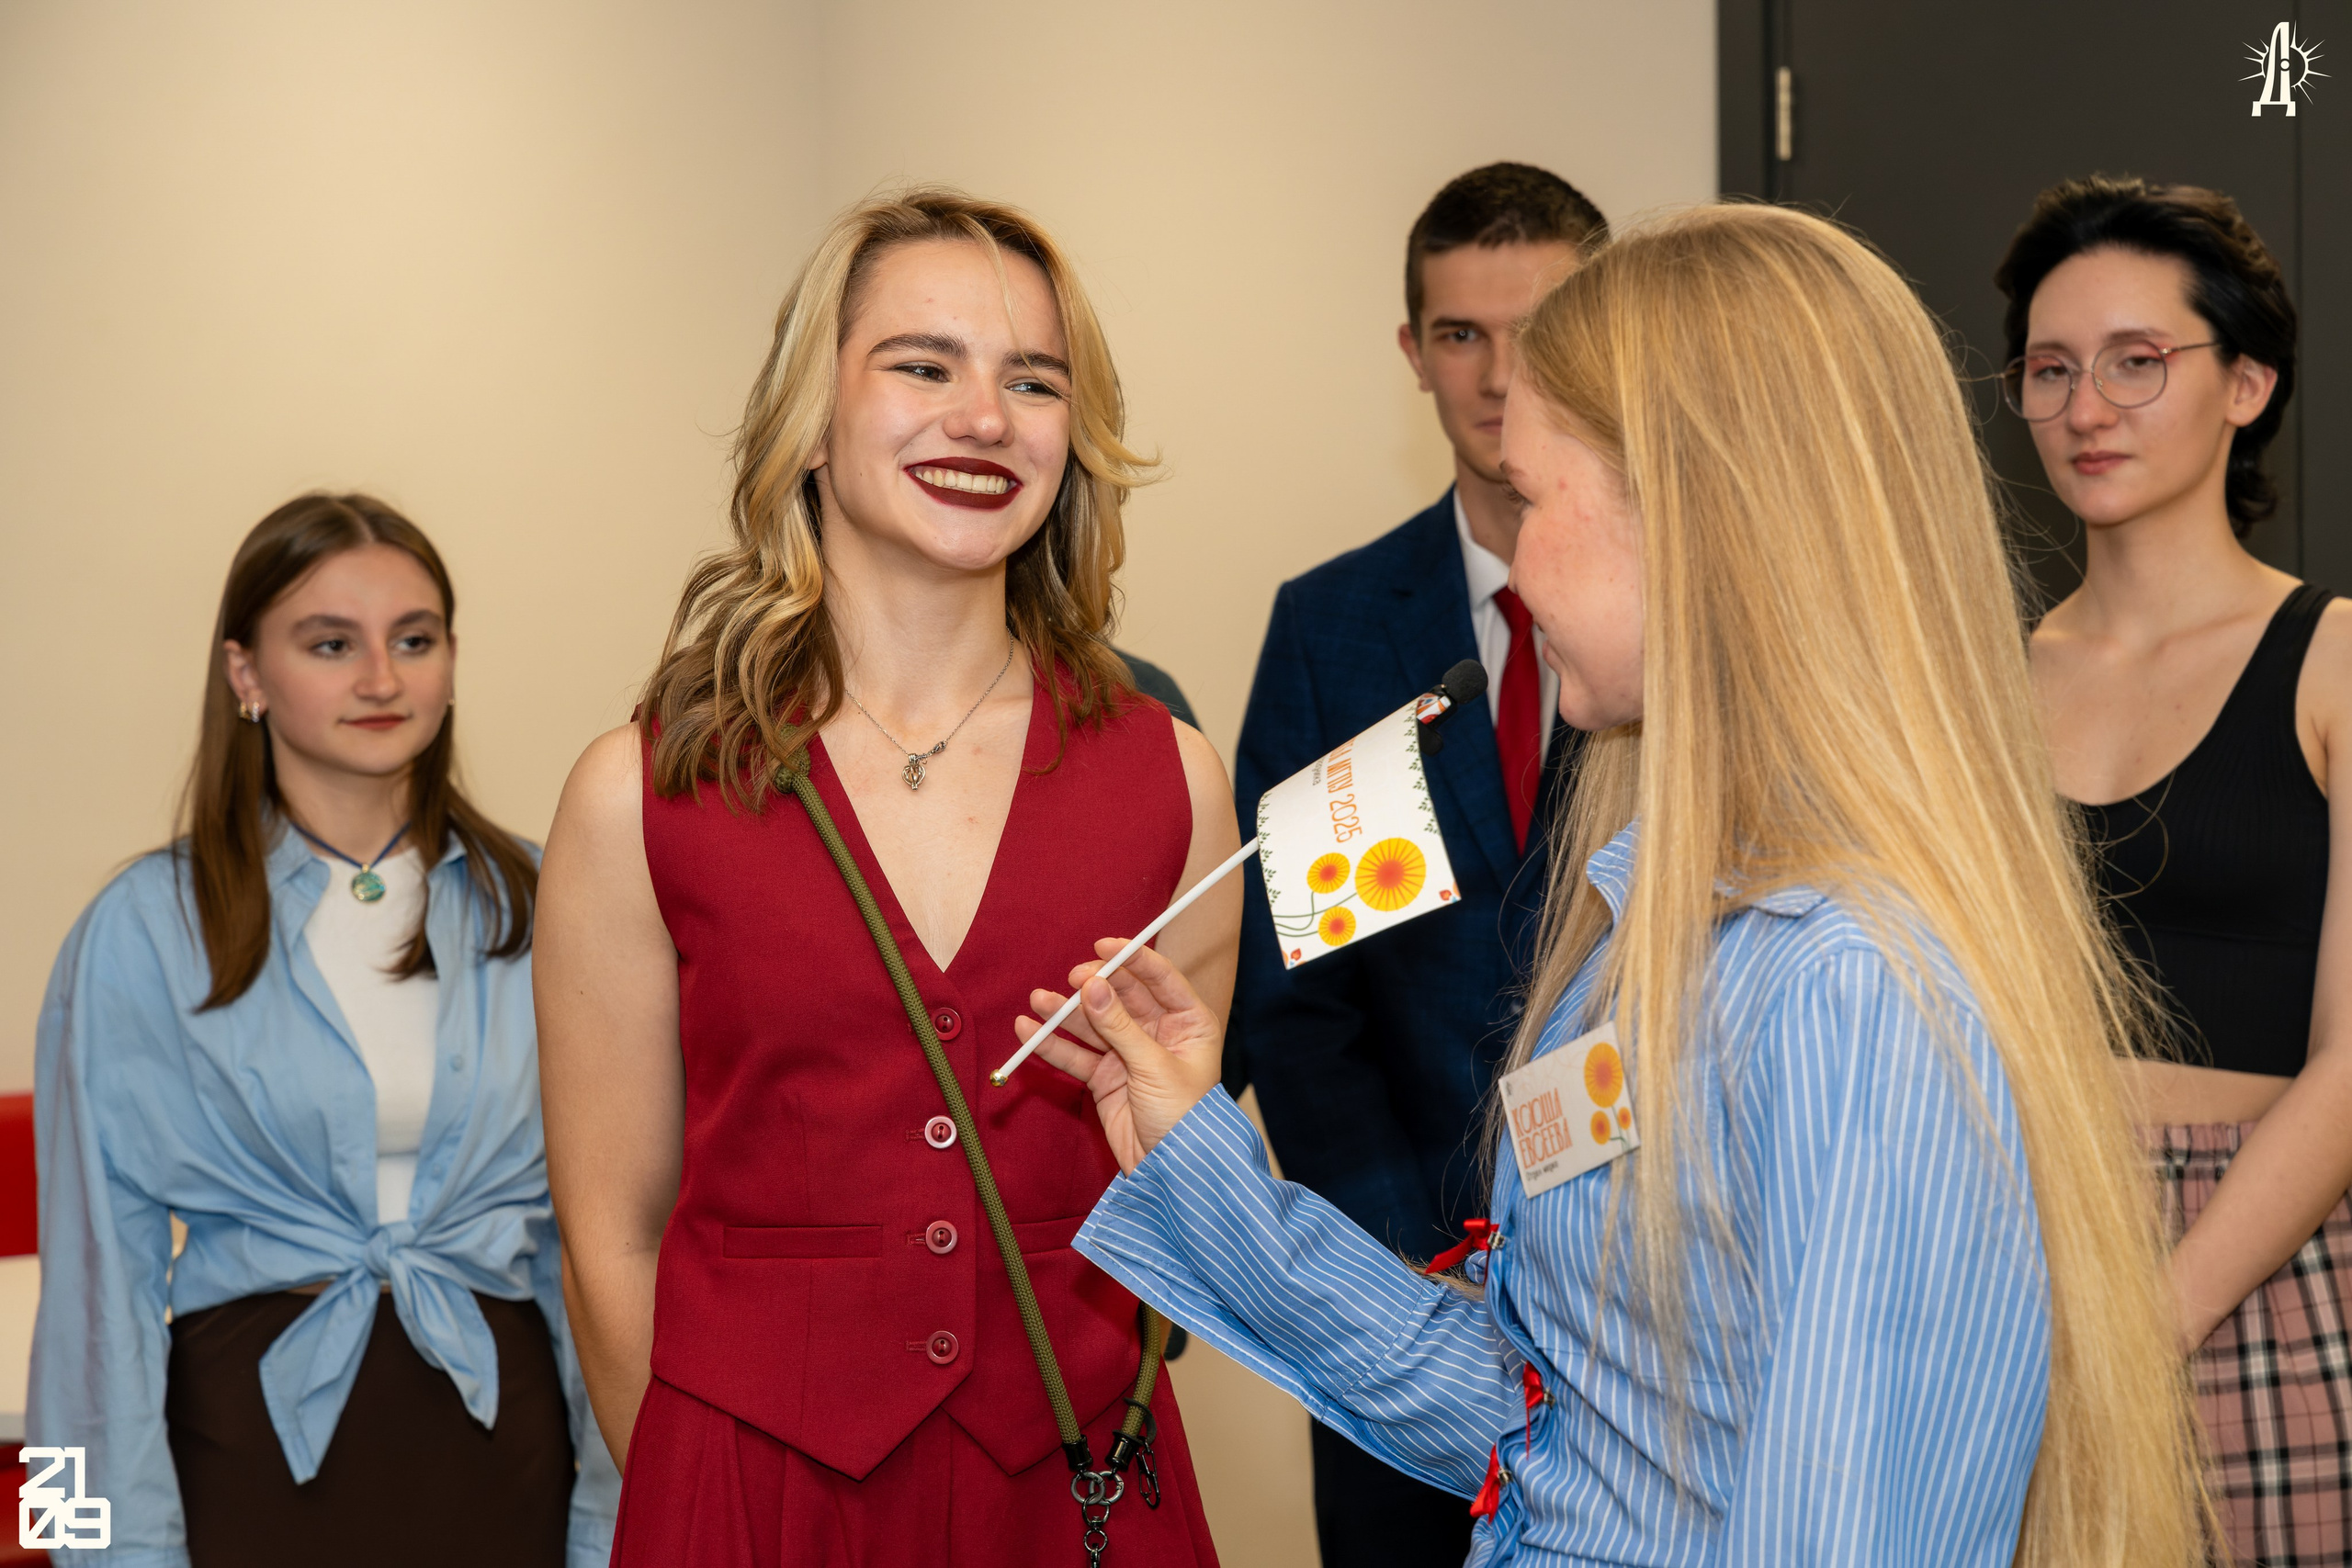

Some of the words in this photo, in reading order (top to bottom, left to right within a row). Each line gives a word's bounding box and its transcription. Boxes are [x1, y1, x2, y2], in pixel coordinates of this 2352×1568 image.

[1329, 793, 1363, 843] 2025
[1511, 1087, 1564, 1138] КСЮША
[1518, 1116, 1574, 1170] ЕВСЕЕВА
